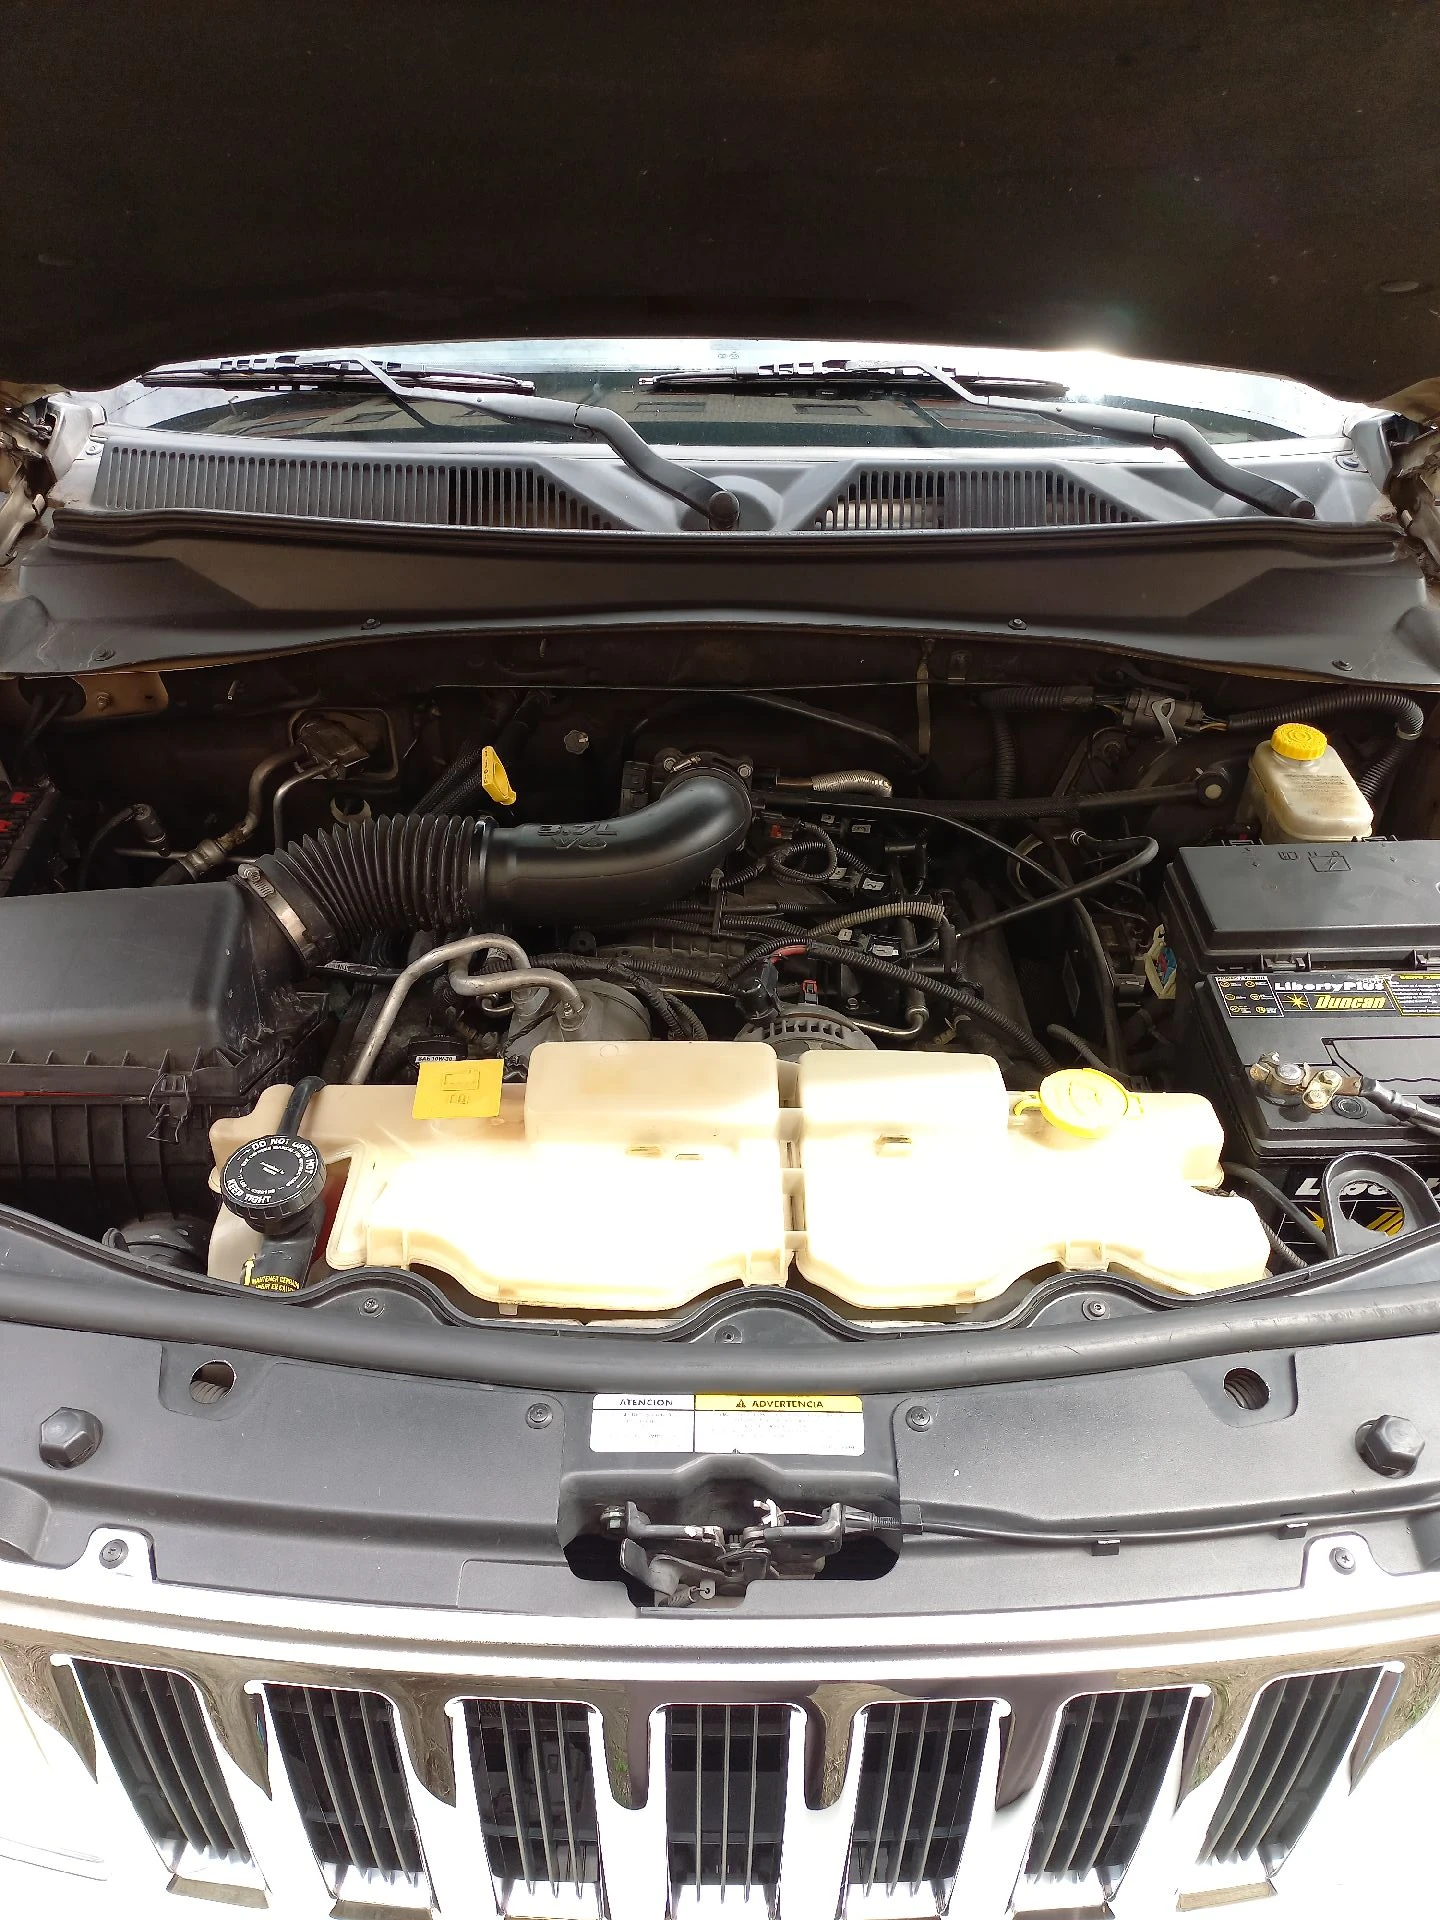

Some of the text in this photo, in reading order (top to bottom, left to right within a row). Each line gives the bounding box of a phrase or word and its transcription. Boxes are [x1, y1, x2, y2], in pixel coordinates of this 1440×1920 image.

[1314, 994, 1386, 1009] Duncan
[251, 1140, 267, 1151] DO
[304, 1158, 316, 1175] HOT
[226, 1178, 271, 1204] KEEP TIGHT
[752, 1400, 824, 1408] ADVERTENCIA
